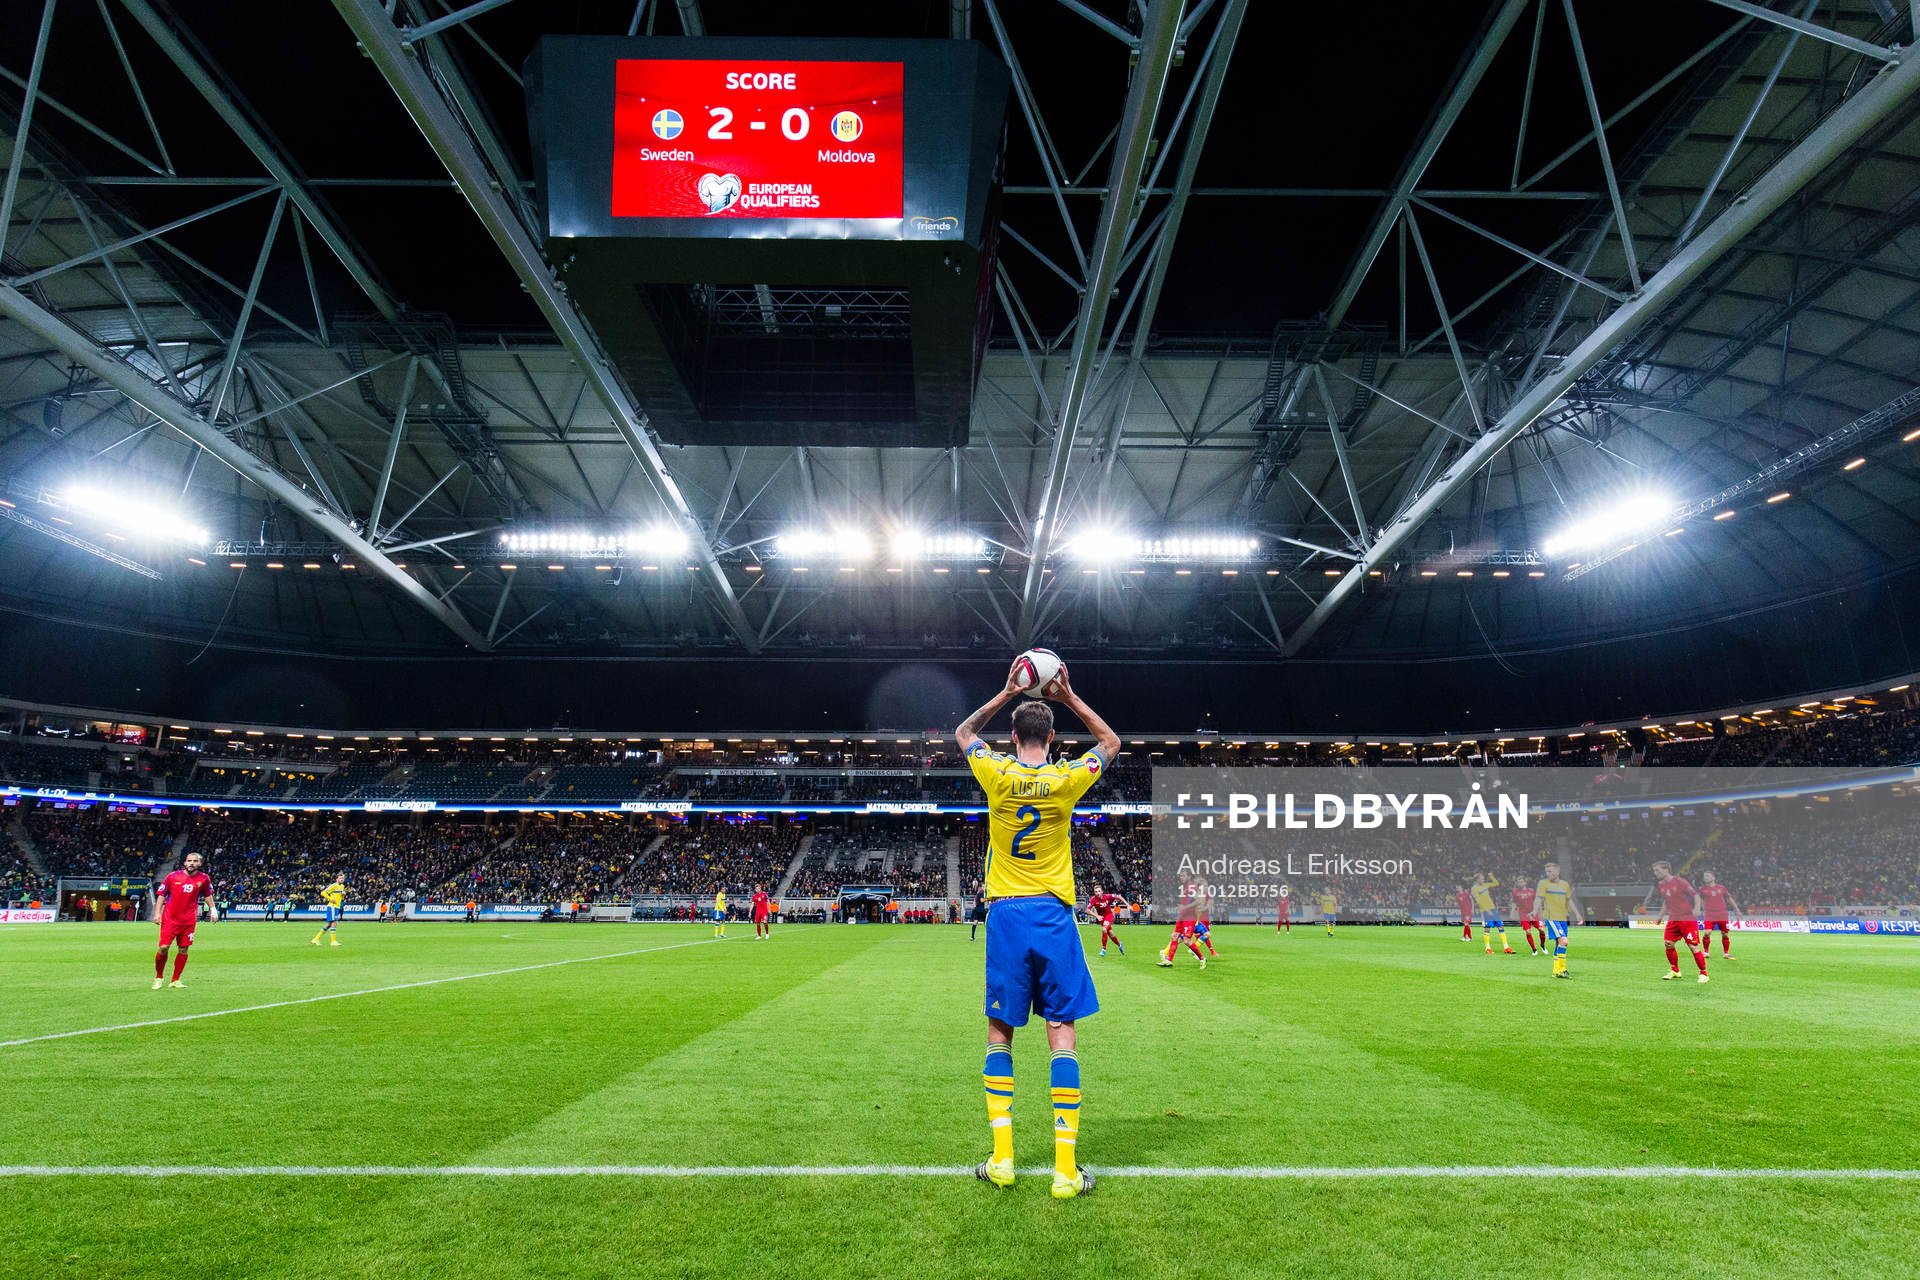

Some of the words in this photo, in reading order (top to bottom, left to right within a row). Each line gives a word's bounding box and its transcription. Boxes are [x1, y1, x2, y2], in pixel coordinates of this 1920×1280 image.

[726, 72, 796, 90] SCORE
[707, 107, 733, 140] 2
[781, 107, 810, 141] 0
[640, 148, 694, 161] Sweden
[818, 149, 875, 163] Moldova
[748, 183, 812, 195] EUROPEAN
[740, 194, 820, 208] QUALIFIERS
[917, 221, 951, 230] friends
[37, 787, 67, 798] 61:00
[1011, 780, 1050, 797] LUSTIG
[364, 801, 436, 810] NATIONALSPORTEN
[620, 802, 692, 811] NATIONALSPORTEN
[866, 803, 937, 812] NATIONALSPORTEN
[1011, 805, 1041, 860] 2
[182, 884, 193, 893] 19
[1745, 918, 1782, 929] elkedjan
